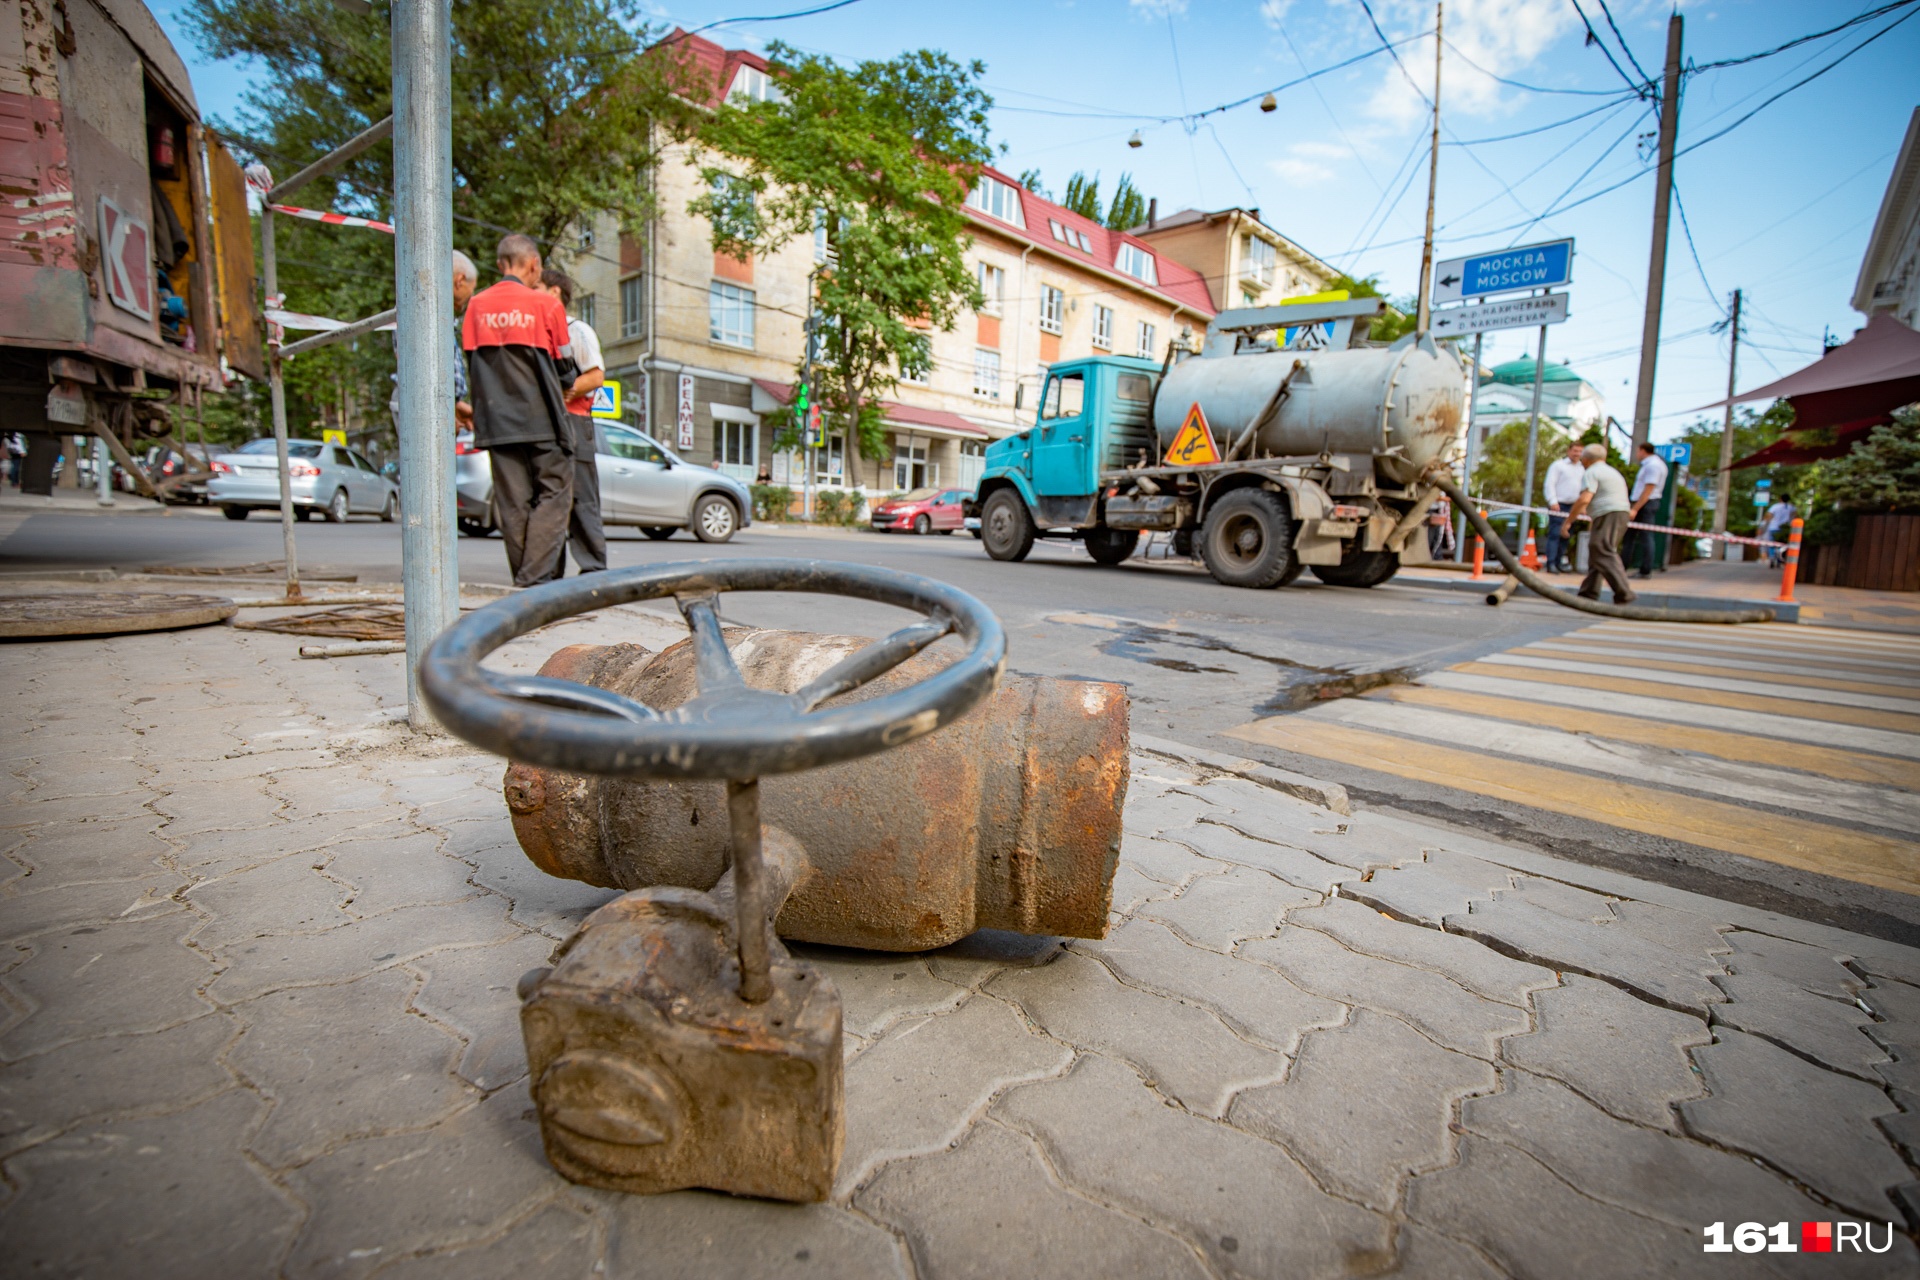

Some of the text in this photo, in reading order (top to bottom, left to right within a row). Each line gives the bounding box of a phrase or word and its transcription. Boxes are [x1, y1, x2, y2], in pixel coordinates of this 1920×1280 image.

[1479, 252, 1546, 273] МОСКВА
[1476, 268, 1548, 289] MOSCOW
[680, 377, 693, 446] РЕАМЕД
